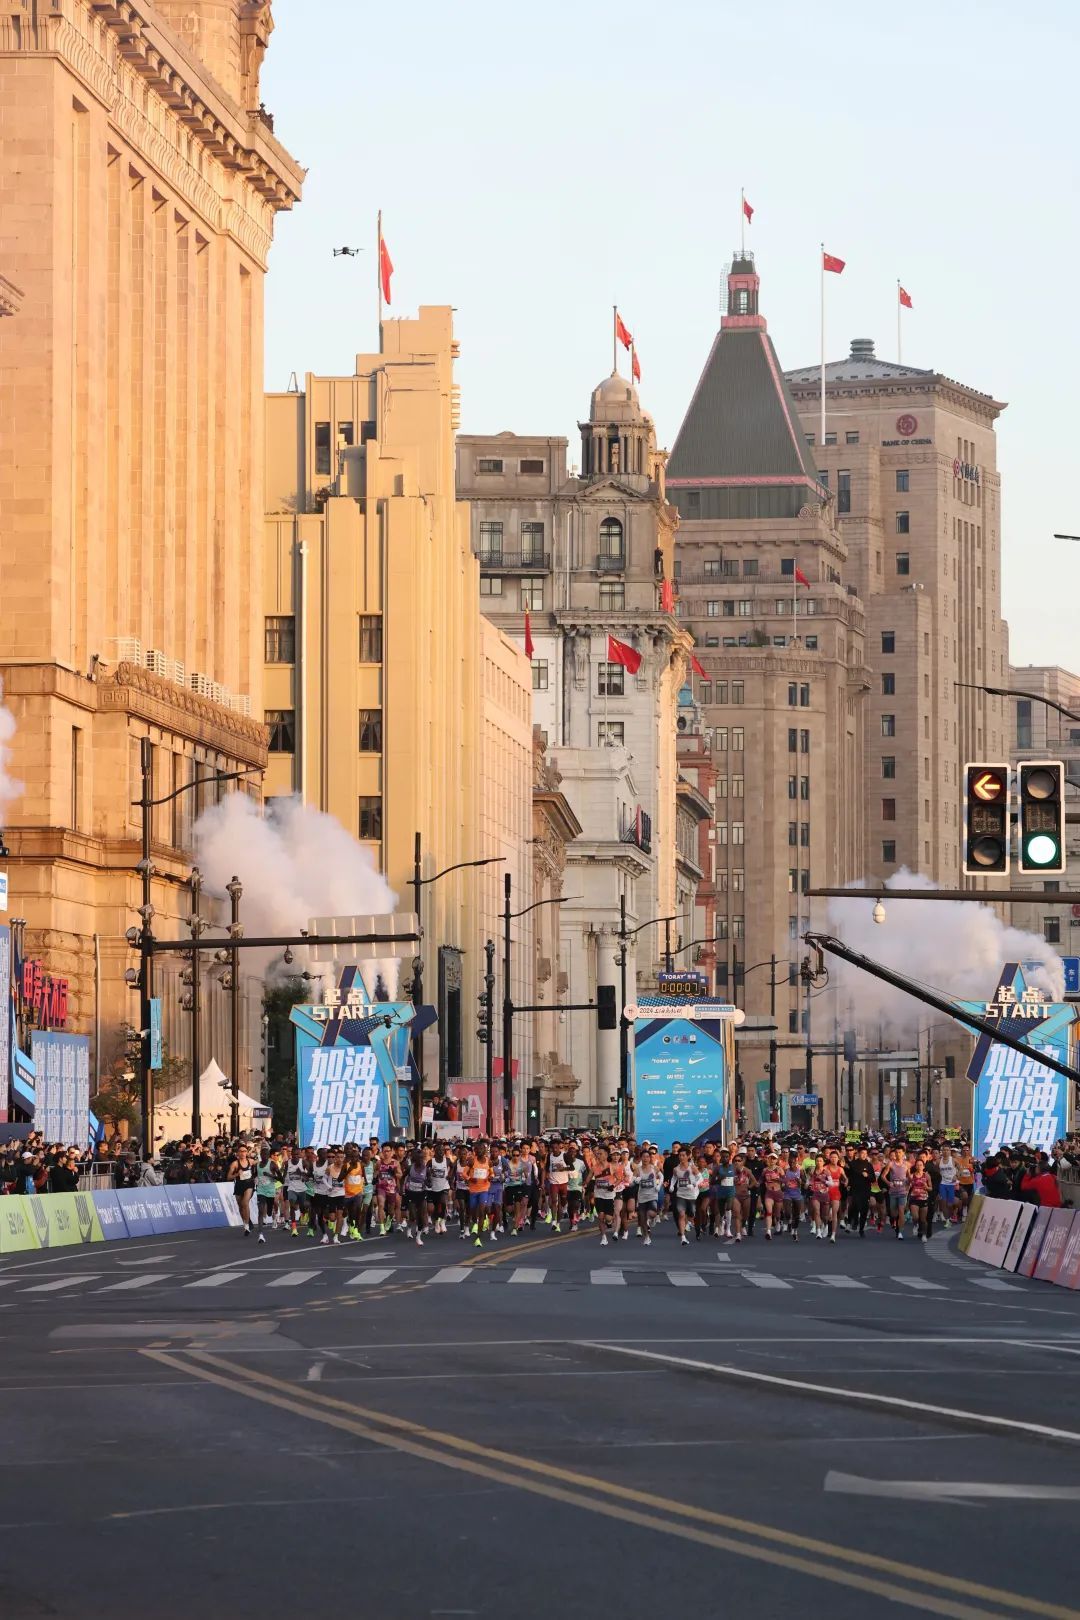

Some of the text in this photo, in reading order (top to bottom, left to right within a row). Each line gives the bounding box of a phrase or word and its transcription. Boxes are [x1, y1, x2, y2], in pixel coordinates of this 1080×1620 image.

[324, 988, 364, 1005] 起点
[985, 1002, 1052, 1019] START
[998, 986, 1044, 1003] 起点
[312, 1004, 376, 1021] START
[308, 1047, 378, 1082] 加油
[984, 1044, 1059, 1078] 加油
[308, 1080, 380, 1114] 加油
[984, 1072, 1059, 1111] 加油
[309, 1112, 380, 1148] 加油
[984, 1105, 1059, 1145] 加油
